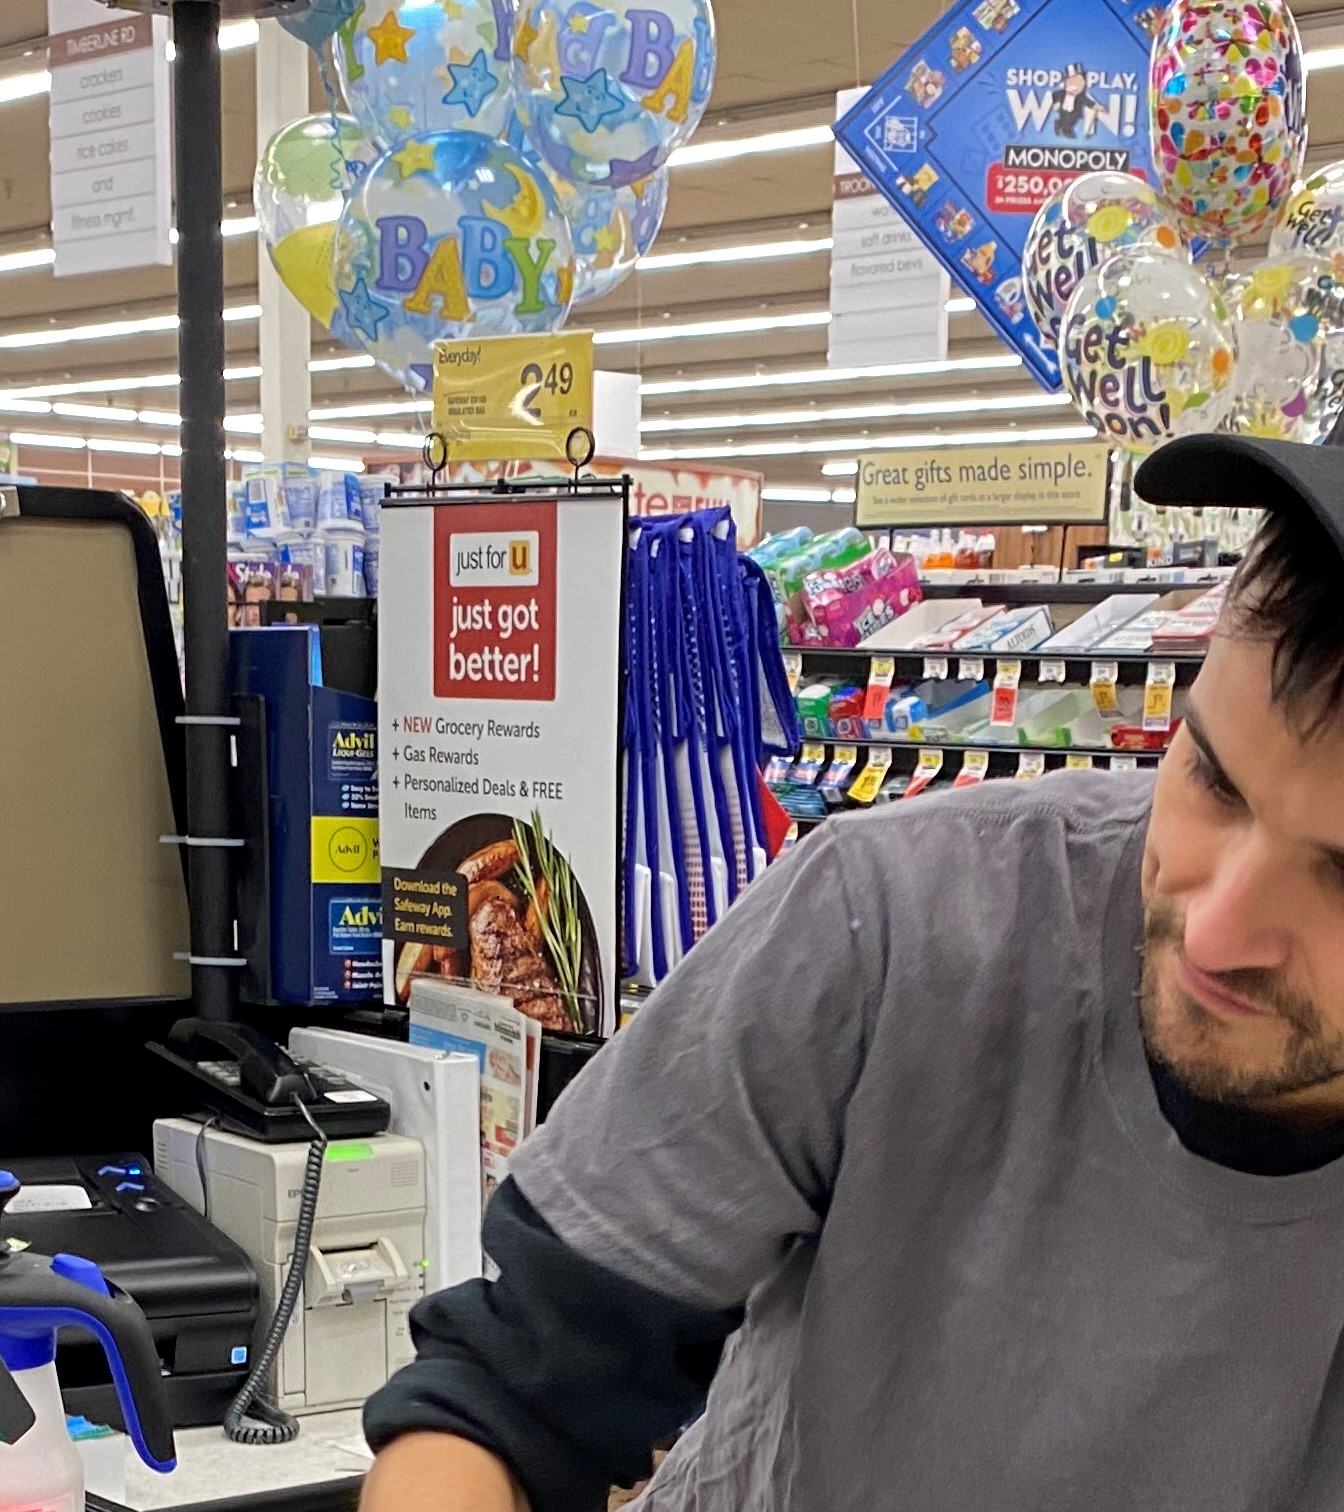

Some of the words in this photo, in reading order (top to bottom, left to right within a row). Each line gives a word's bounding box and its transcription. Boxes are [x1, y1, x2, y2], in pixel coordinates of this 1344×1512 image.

[1006, 68, 1064, 88] SHOP,
[1087, 71, 1138, 91] PLAY,
[82, 104, 122, 124] cookies
[1009, 149, 1127, 171] MONOPOLY
[375, 215, 555, 322] BABY
[863, 462, 909, 486] Great
[915, 458, 952, 491] gifts
[960, 458, 1010, 482] made
[1019, 453, 1092, 486] simple.
[456, 547, 483, 576] just
[487, 545, 507, 569] for
[512, 546, 527, 570] u
[1147, 556, 1173, 568] KIND
[449, 596, 492, 638] just
[498, 599, 539, 639] got
[449, 642, 539, 682] better!
[403, 716, 432, 733] NEW
[435, 718, 484, 740] Grocery
[487, 719, 540, 738] Rewards
[332, 732, 376, 750] Advil
[403, 745, 425, 762] Gas
[429, 747, 479, 765] Rewards
[404, 773, 479, 794] Personalized
[483, 778, 516, 797] Deals
[519, 781, 528, 798] &
[532, 782, 564, 800] FREE
[404, 802, 437, 821] Items
[335, 844, 360, 855] Advil
[394, 876, 440, 895] Download
[442, 881, 457, 896] the
[394, 897, 431, 917] Safeway
[432, 902, 452, 917] App.
[395, 917, 414, 933] Earn
[415, 920, 453, 938] rewards.
